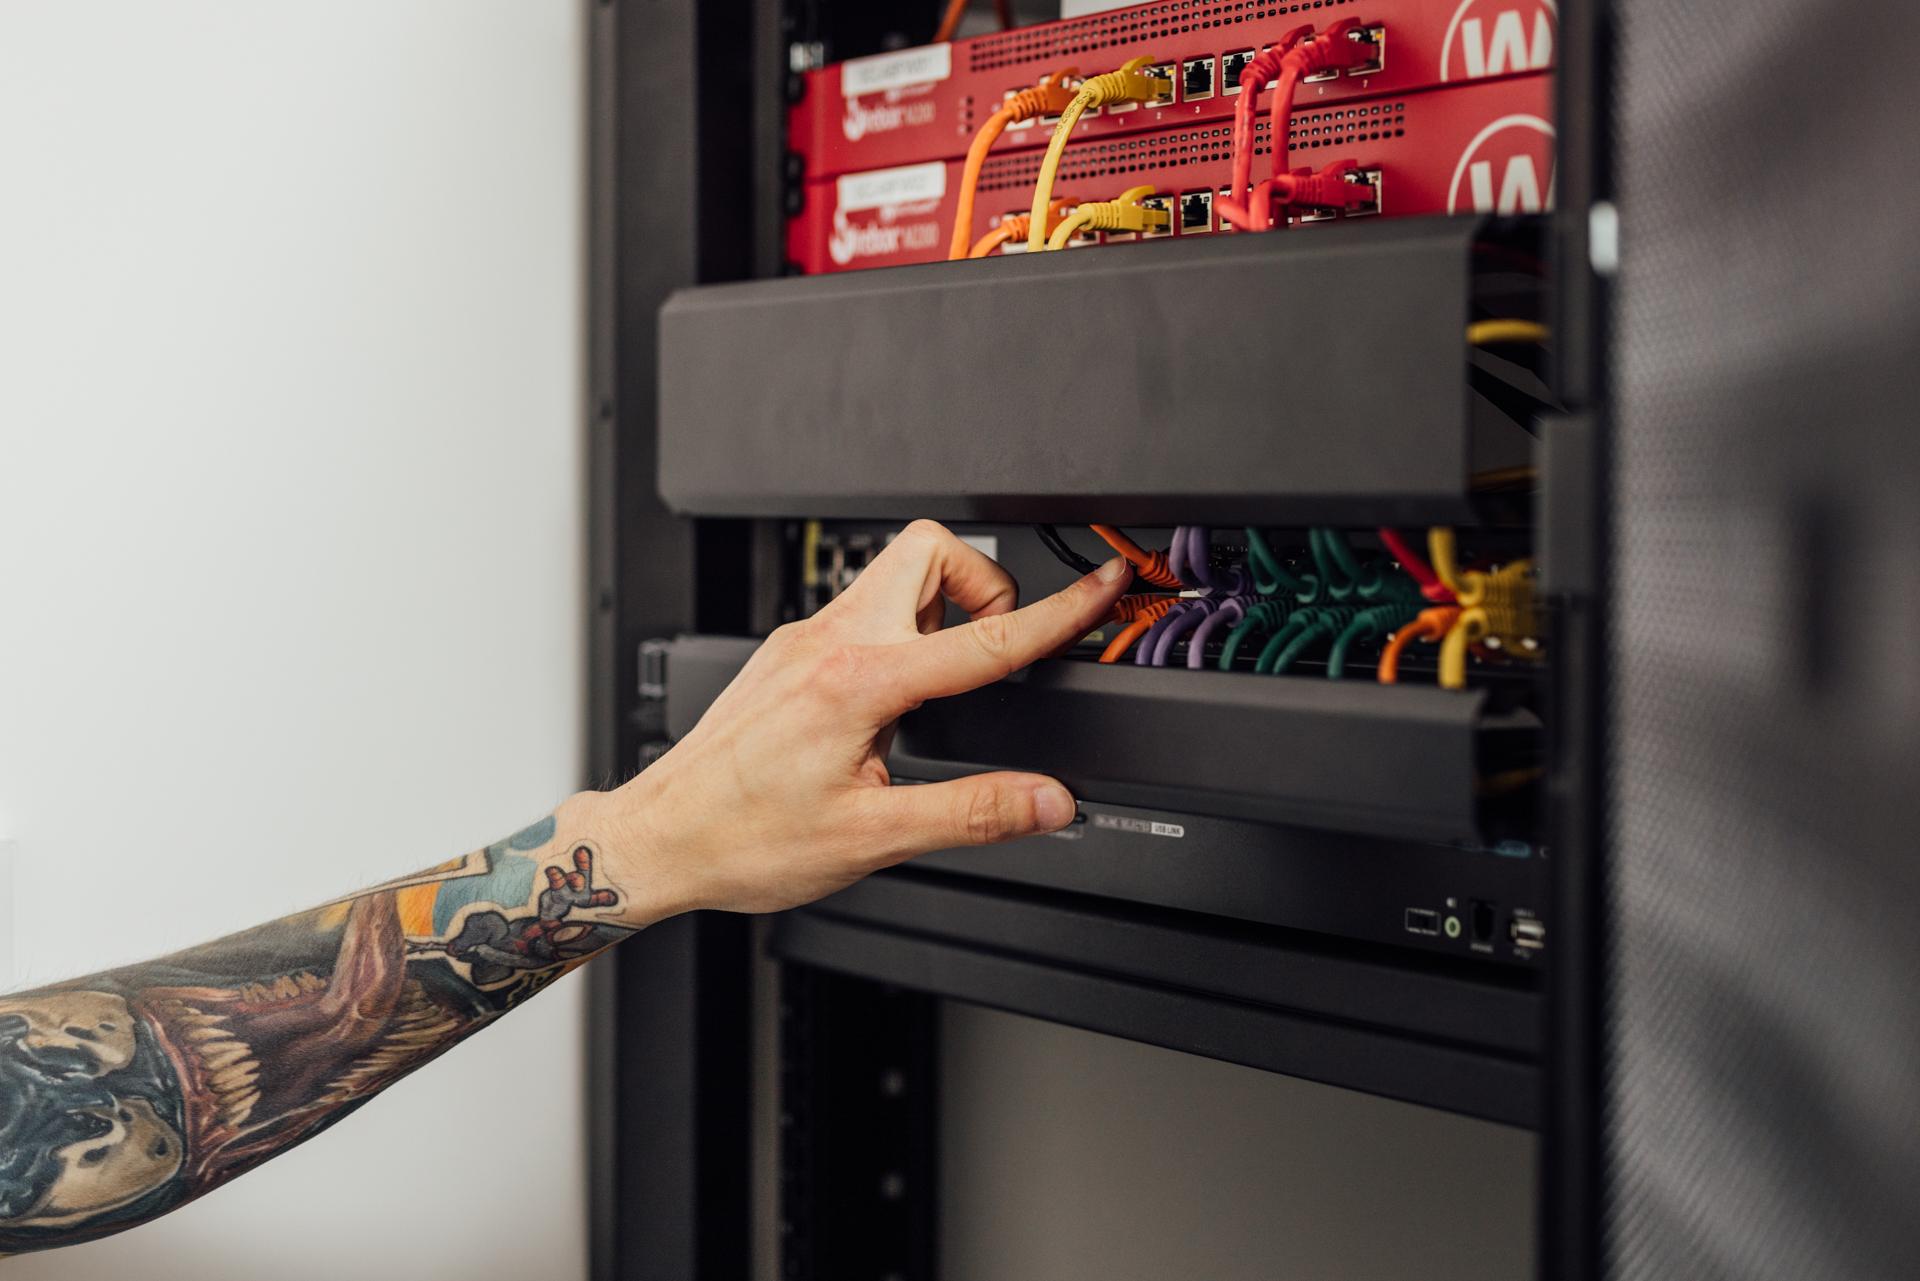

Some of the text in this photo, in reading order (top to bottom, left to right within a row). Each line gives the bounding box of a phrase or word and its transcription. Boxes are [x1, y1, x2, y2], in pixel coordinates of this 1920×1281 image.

[1462, 9, 1553, 78] W
[1195, 105, 1200, 114] 3
[1318, 86, 1323, 95] 6
[1363, 79, 1368, 88] 7
[1167, 826, 1181, 835] LINK
